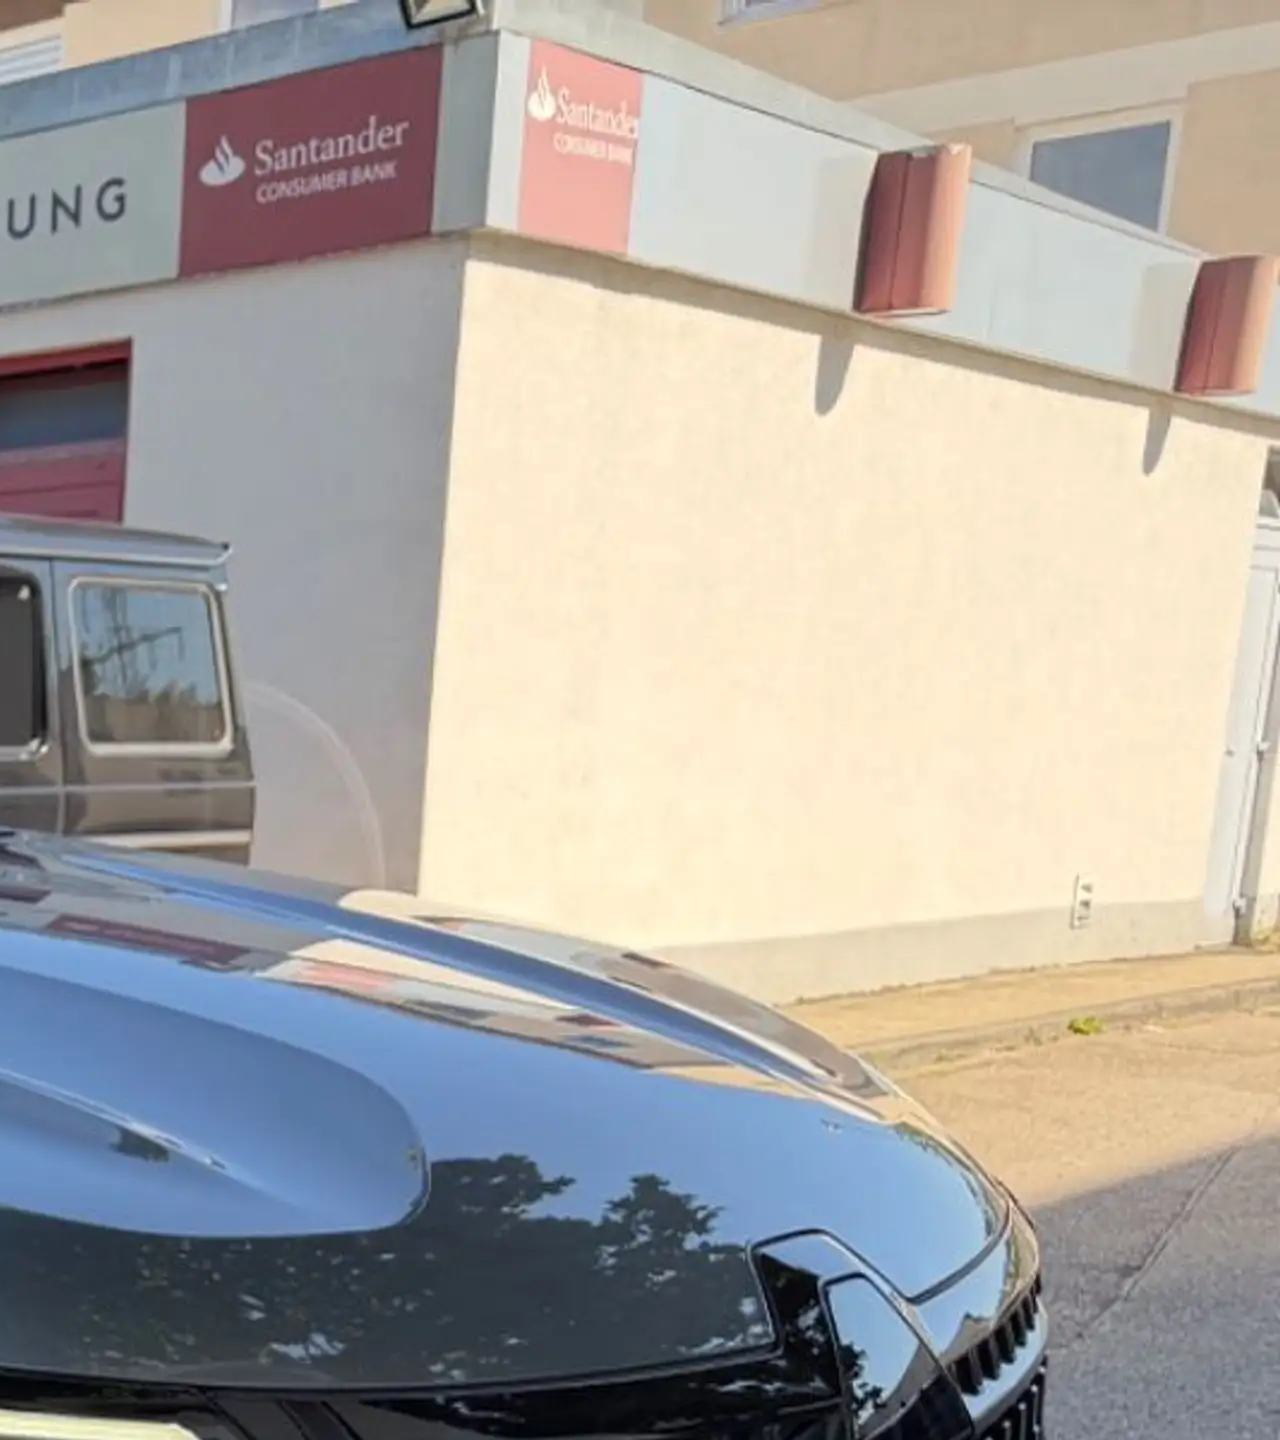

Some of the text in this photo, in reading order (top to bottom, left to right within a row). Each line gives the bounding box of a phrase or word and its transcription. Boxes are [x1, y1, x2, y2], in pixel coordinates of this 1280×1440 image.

[253, 114, 410, 176] Santander
[255, 160, 397, 204] CONSUMER BANK
